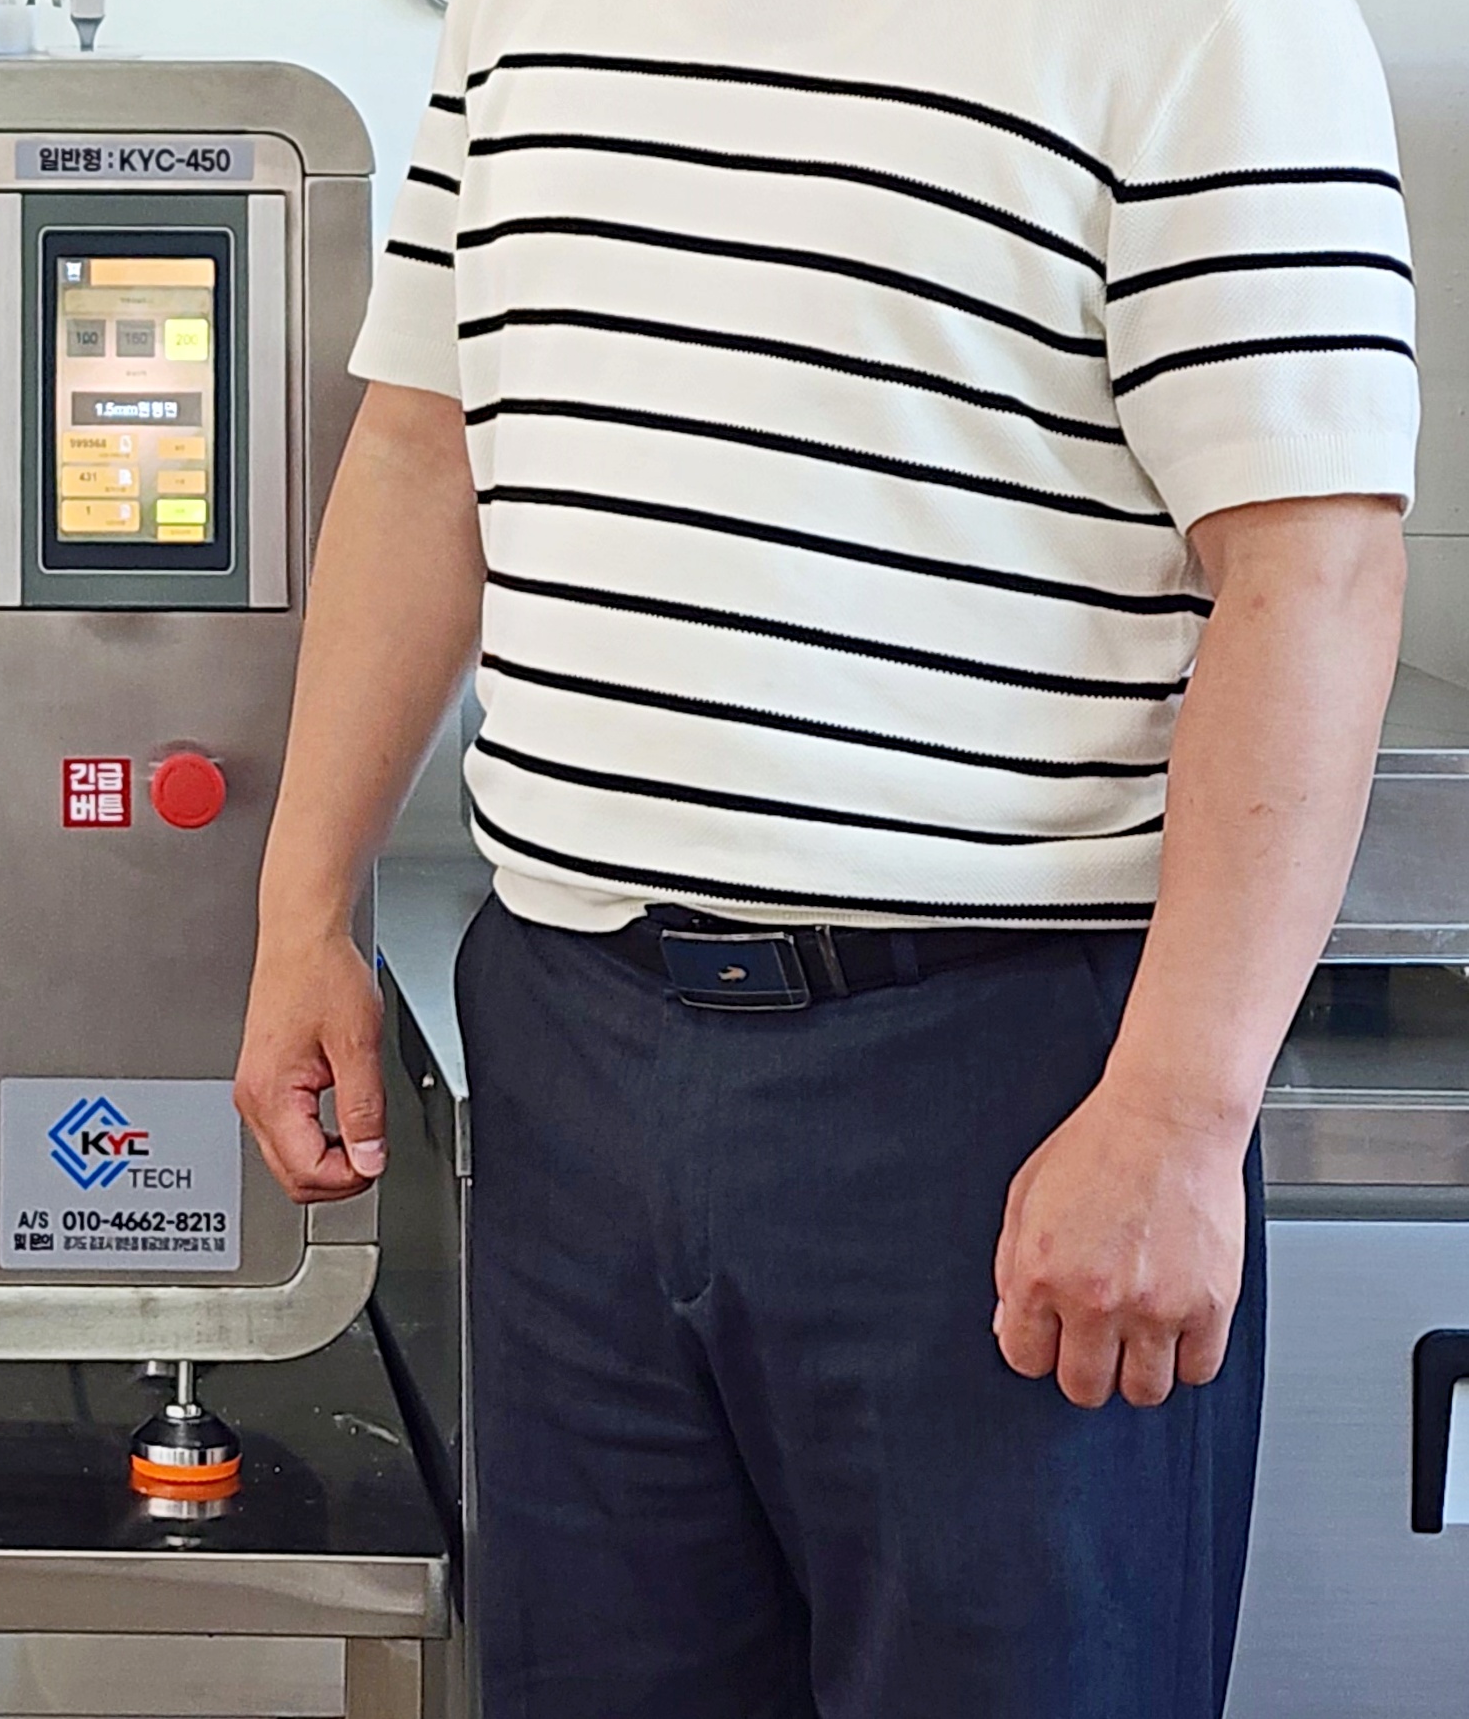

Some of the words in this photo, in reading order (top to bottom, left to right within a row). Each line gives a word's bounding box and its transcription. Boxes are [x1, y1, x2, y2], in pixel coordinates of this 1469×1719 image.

[39, 149, 102, 172] 일반형
[119, 149, 231, 172] KYC-450
[70, 763, 123, 791] 긴급
[70, 794, 124, 822] 버튼
[81, 1131, 150, 1156] KYC
[128, 1168, 192, 1188] TECH
[18, 1211, 49, 1229] A/S
[62, 1211, 226, 1232] 010-4662-8213
